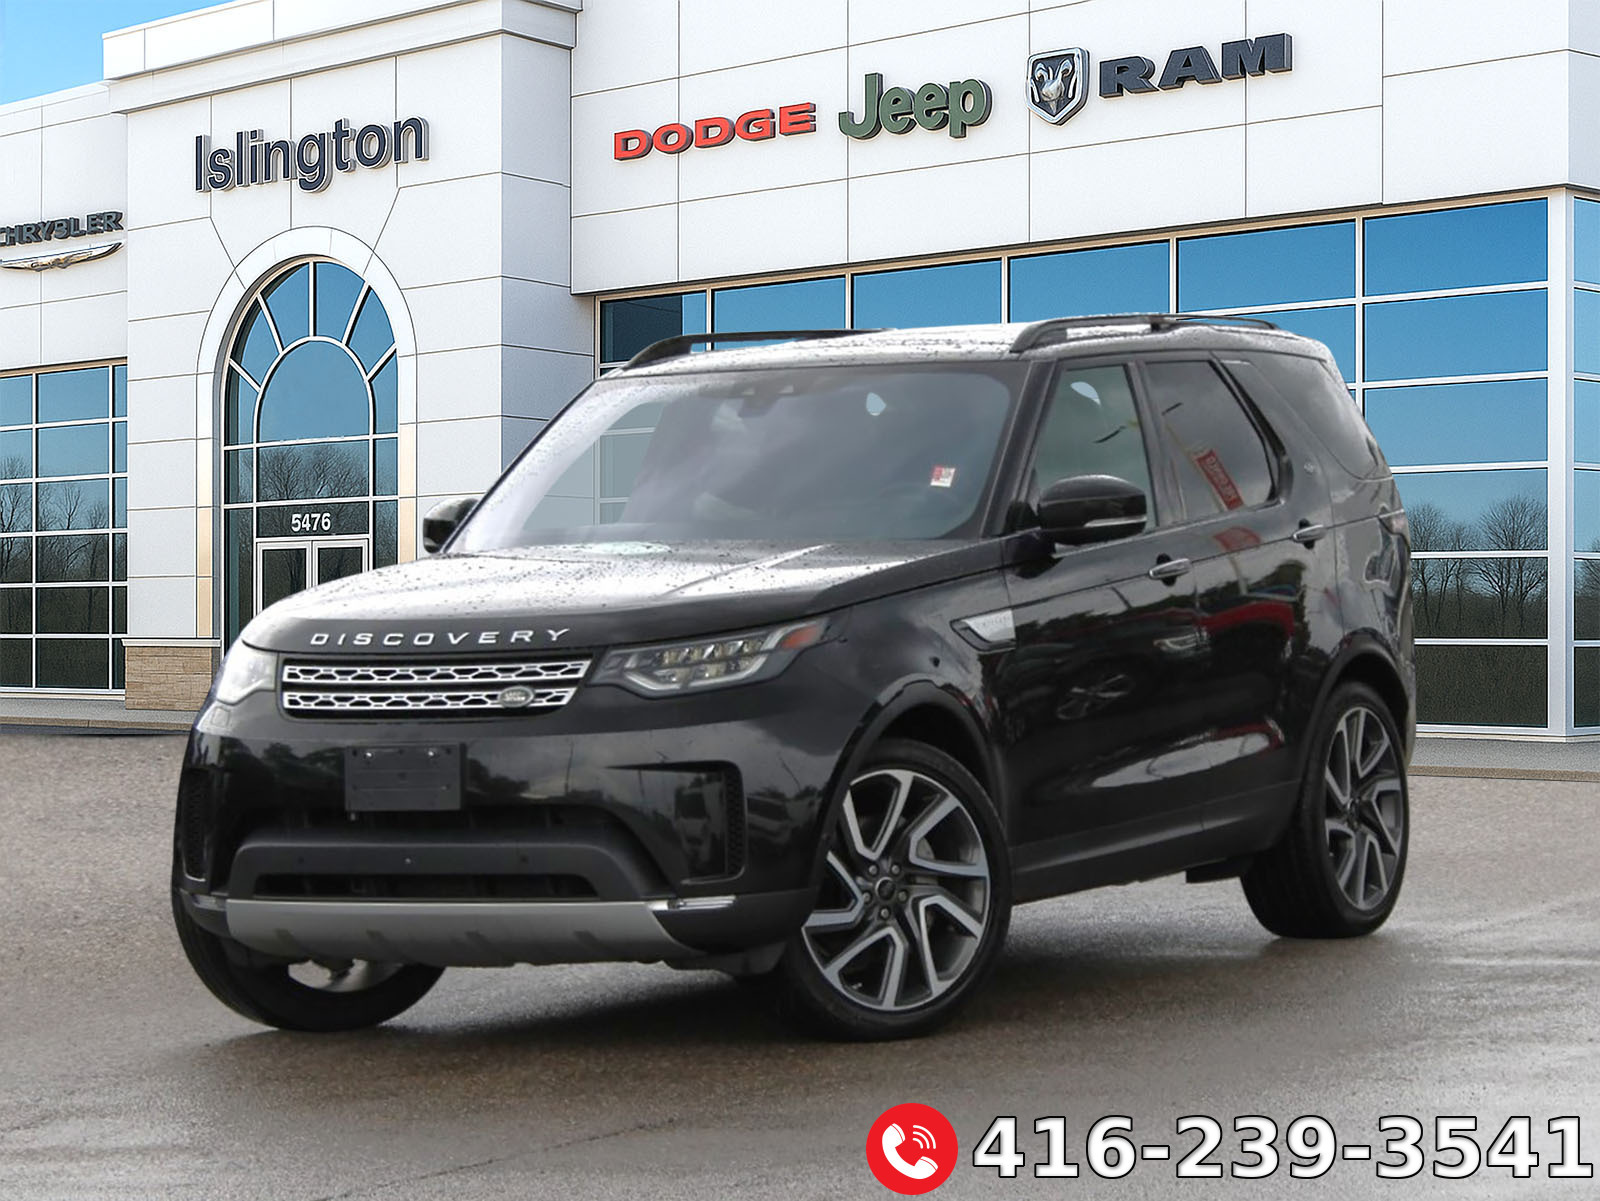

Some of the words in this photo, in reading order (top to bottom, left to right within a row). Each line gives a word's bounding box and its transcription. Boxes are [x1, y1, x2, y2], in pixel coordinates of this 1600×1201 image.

[614, 102, 817, 160] DODGE
[838, 73, 992, 139] Jeep
[1100, 33, 1293, 98] RAM
[195, 117, 429, 191] Islington
[291, 512, 331, 532] 5476
[310, 629, 569, 645] DISCOVERY
